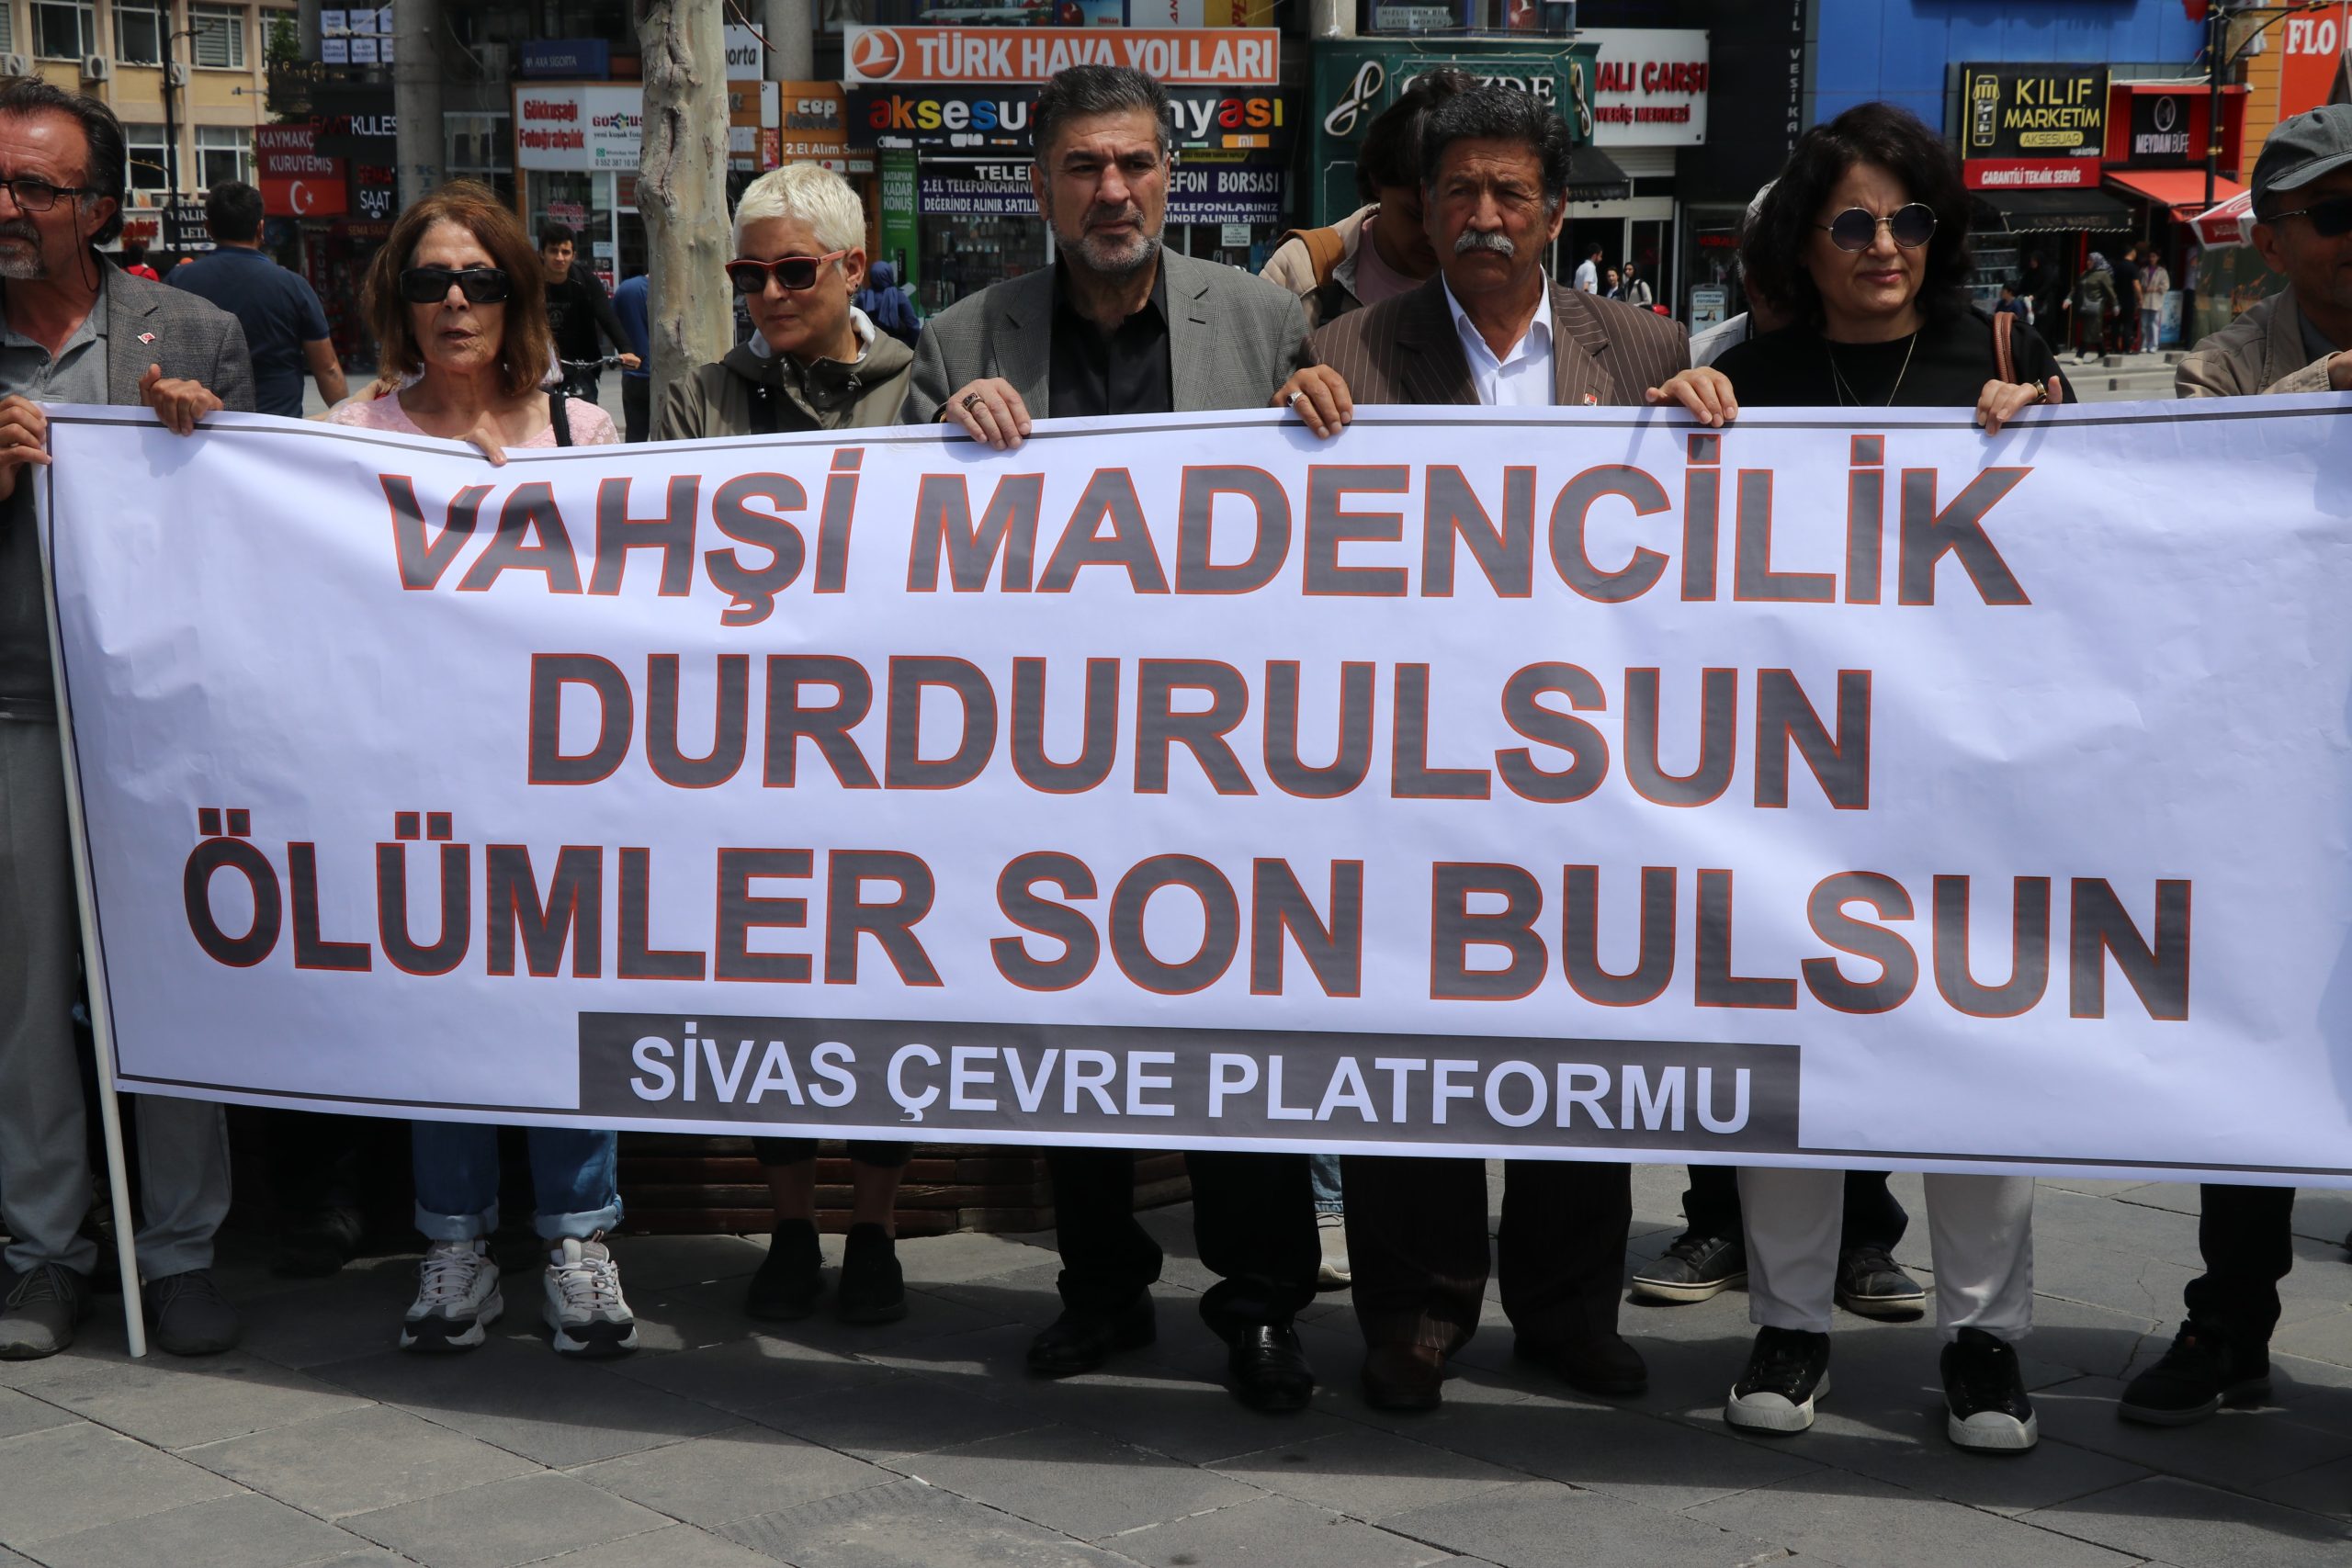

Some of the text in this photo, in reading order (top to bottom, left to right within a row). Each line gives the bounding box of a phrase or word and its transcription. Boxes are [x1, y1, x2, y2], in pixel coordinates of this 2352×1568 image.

[2286, 19, 2336, 55] FLO
[916, 32, 1272, 79] TÜRK HAVA YOLLARI
[1642, 61, 1709, 96] ÇARŞI
[2015, 78, 2094, 106] KILIF
[797, 99, 838, 118] cep
[2004, 104, 2100, 129] MARKETİM
[786, 142, 808, 155] 2.El
[811, 142, 839, 155] Alım
[2135, 132, 2171, 153] MEYDAN
[975, 165, 1032, 181] TELE
[1217, 172, 1279, 193] BORSASI
[883, 182, 913, 197] KADAR
[923, 179, 944, 193] 2.EL
[359, 190, 391, 210] SAAT
[883, 197, 913, 215] KONUŞ
[924, 194, 971, 212] DEĞERİNDE
[973, 197, 1003, 212] ALINIR
[1199, 213, 1239, 223] ALINIR
[1242, 213, 1278, 223] SATILIR
[378, 433, 2036, 627] VAHŞİ MADENCİLİK
[527, 653, 1872, 811] DURDURULSUN
[183, 807, 2192, 1022] ÖLÜMLER SON BULSUN
[629, 1021, 1751, 1134] SİVAS ÇEVRE PLATFORMU
